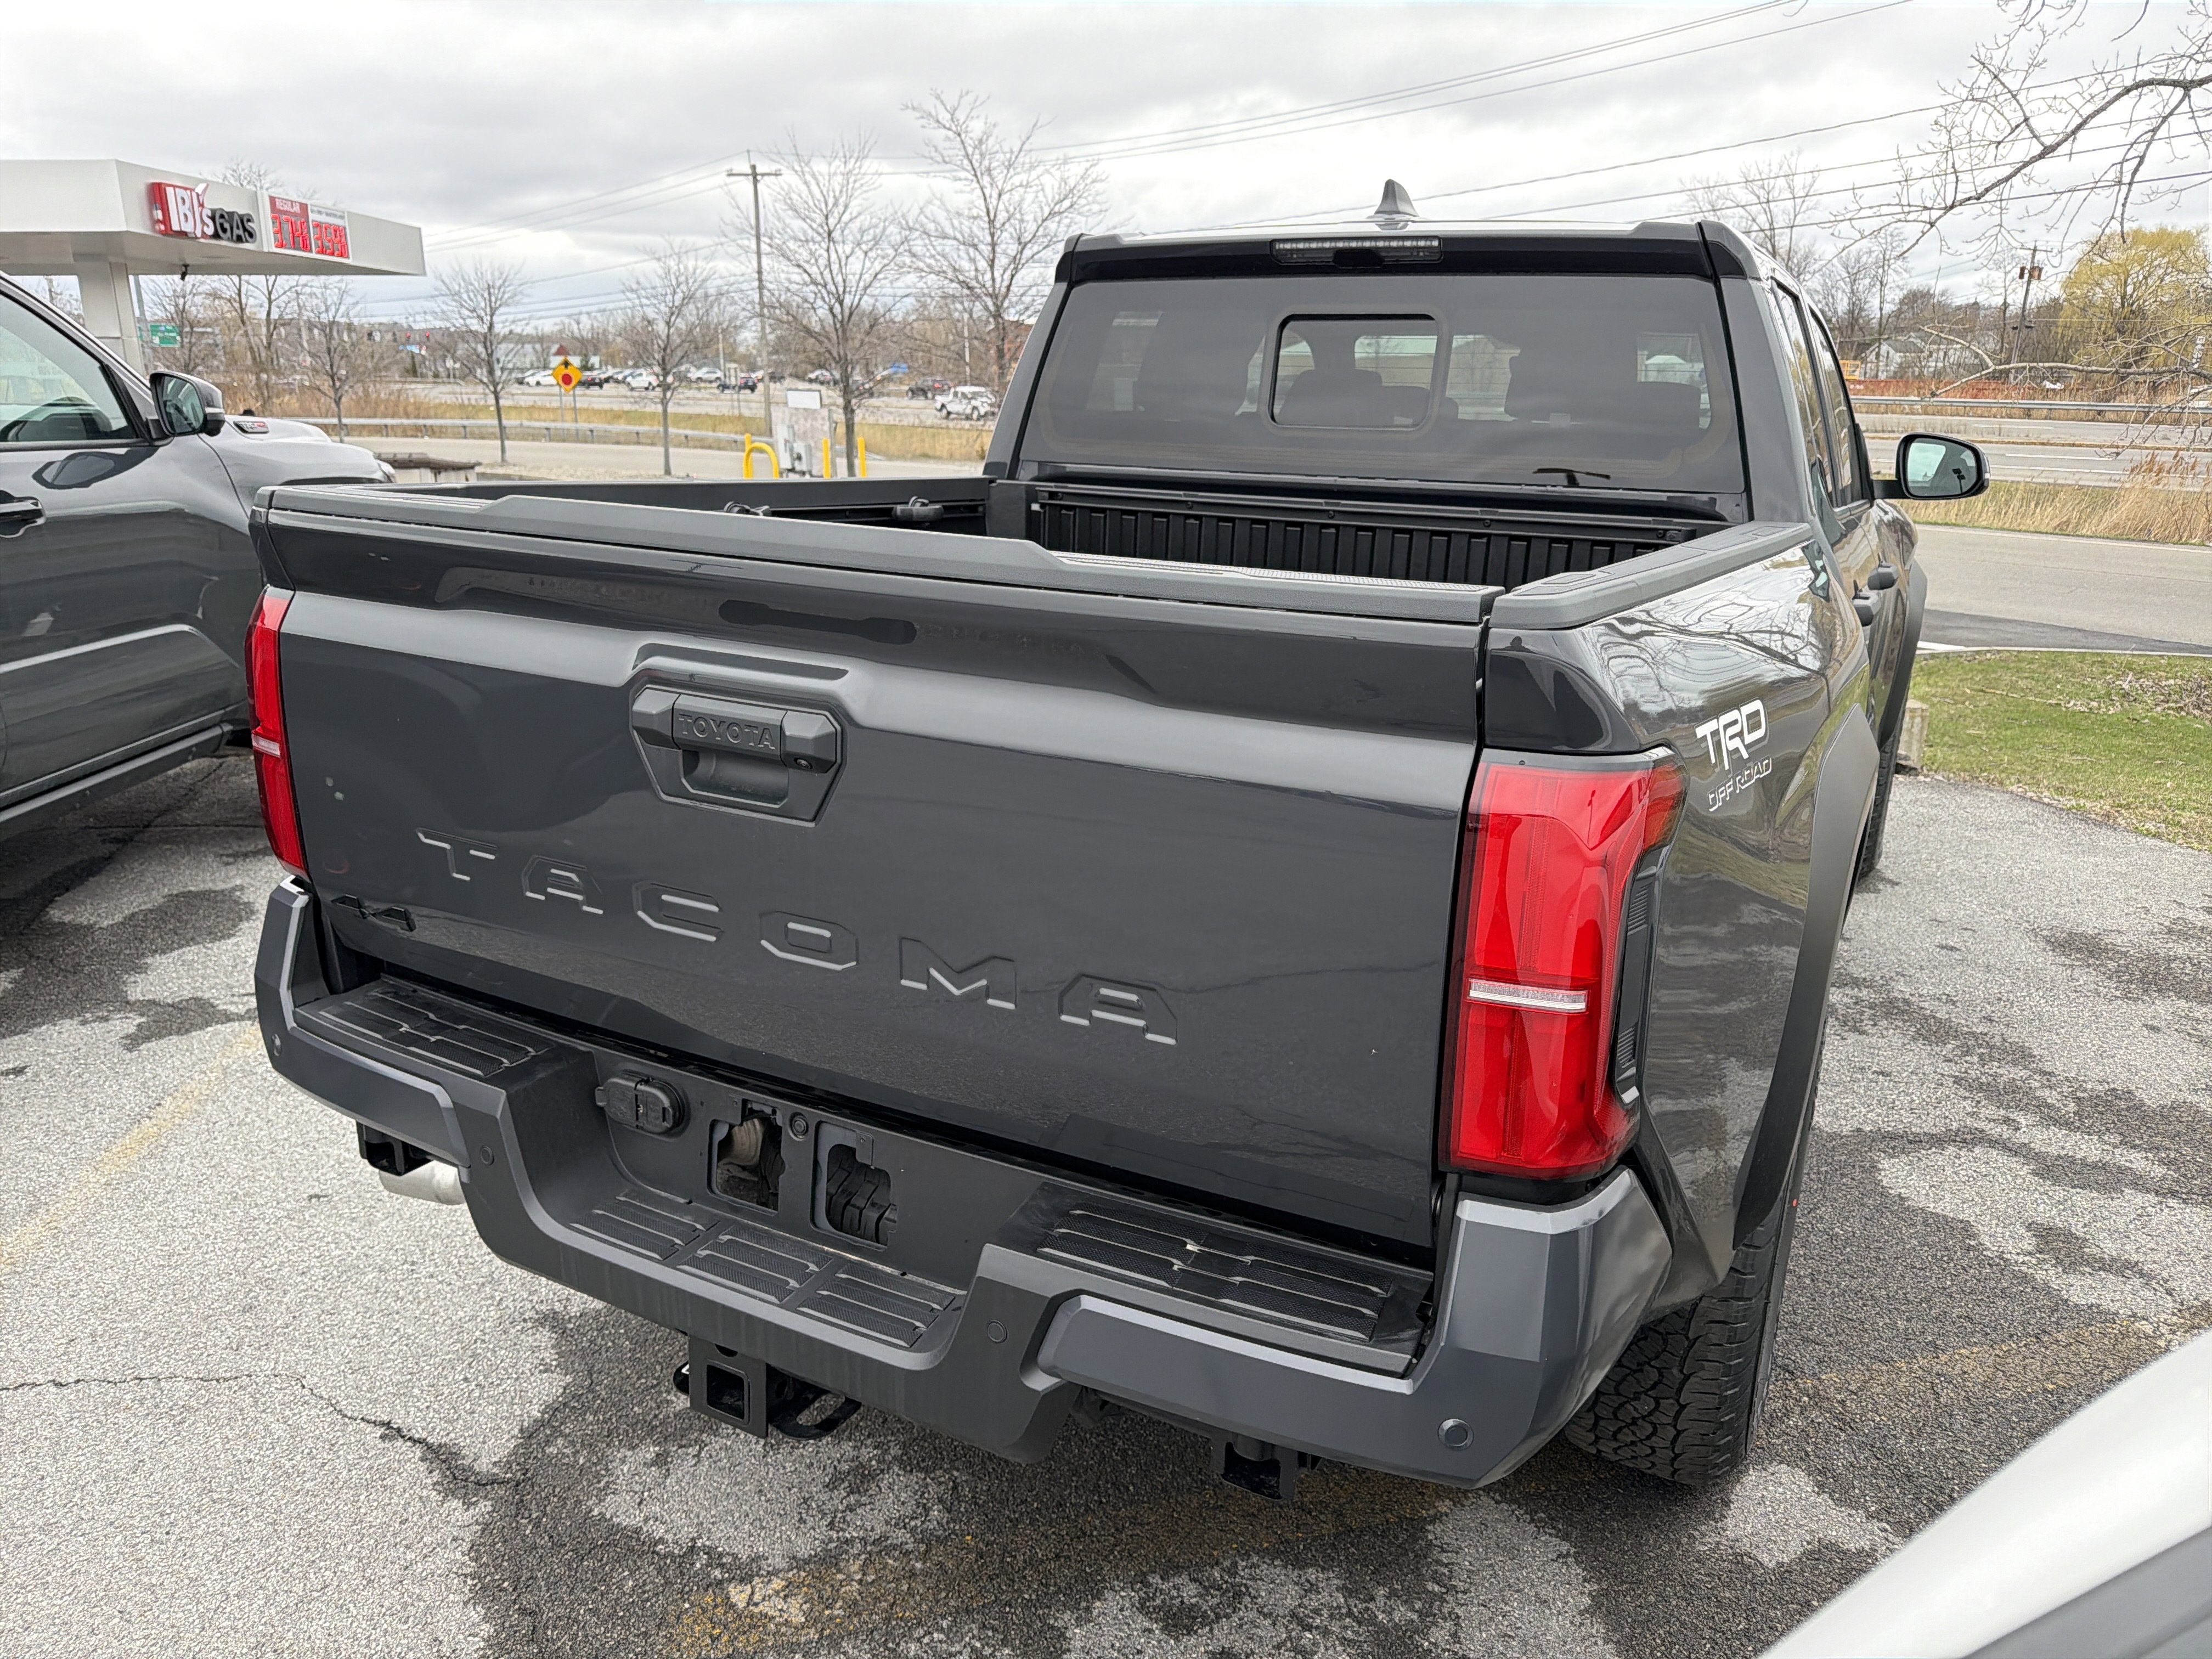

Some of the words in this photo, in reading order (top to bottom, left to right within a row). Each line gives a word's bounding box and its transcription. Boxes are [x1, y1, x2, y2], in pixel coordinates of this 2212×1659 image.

[216, 208, 257, 244] GAS
[678, 713, 776, 750] TOYOTA
[1695, 699, 1767, 770] TRD
[1707, 777, 1734, 812] OFF
[1734, 755, 1772, 794] ROAD
[415, 827, 1178, 1045] TACOMA
